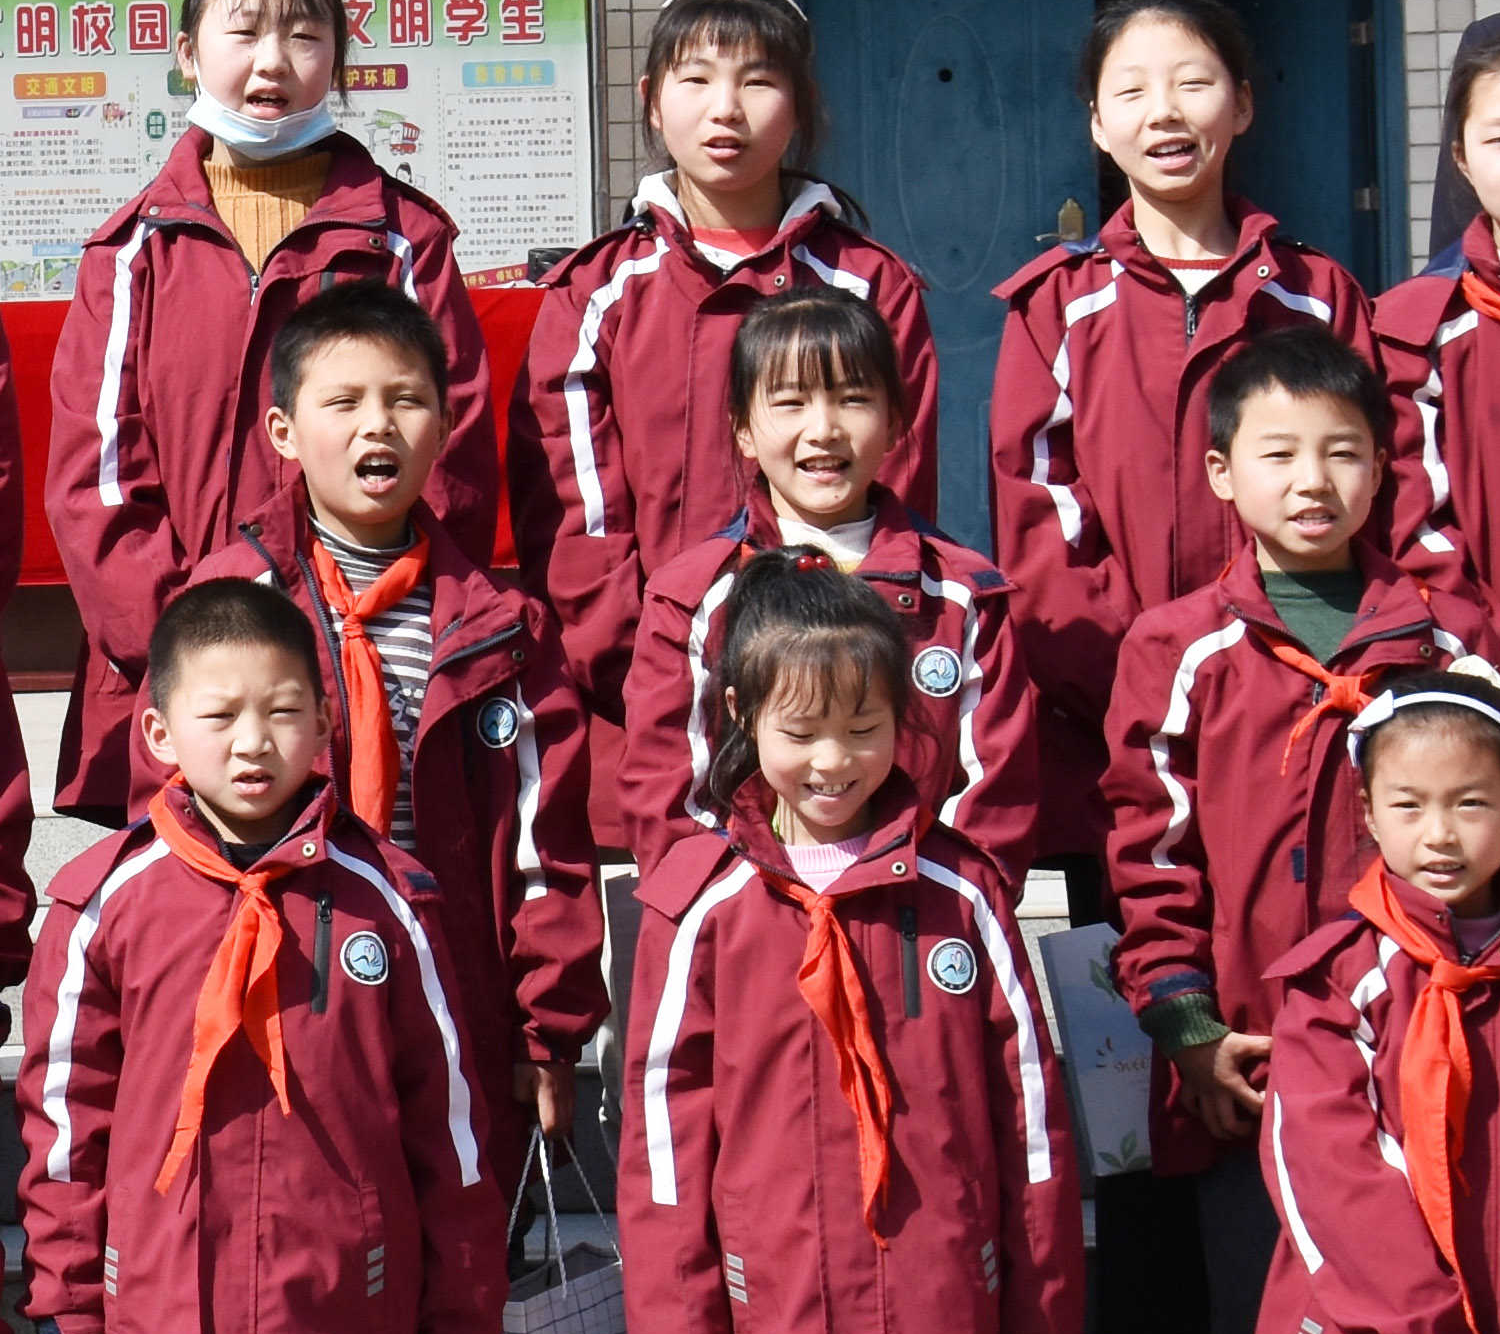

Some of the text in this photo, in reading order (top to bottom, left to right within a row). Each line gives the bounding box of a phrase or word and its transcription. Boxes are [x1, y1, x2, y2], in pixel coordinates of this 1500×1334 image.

[25, 76, 96, 97] 交通文明
[334, 68, 397, 87] 护环境
